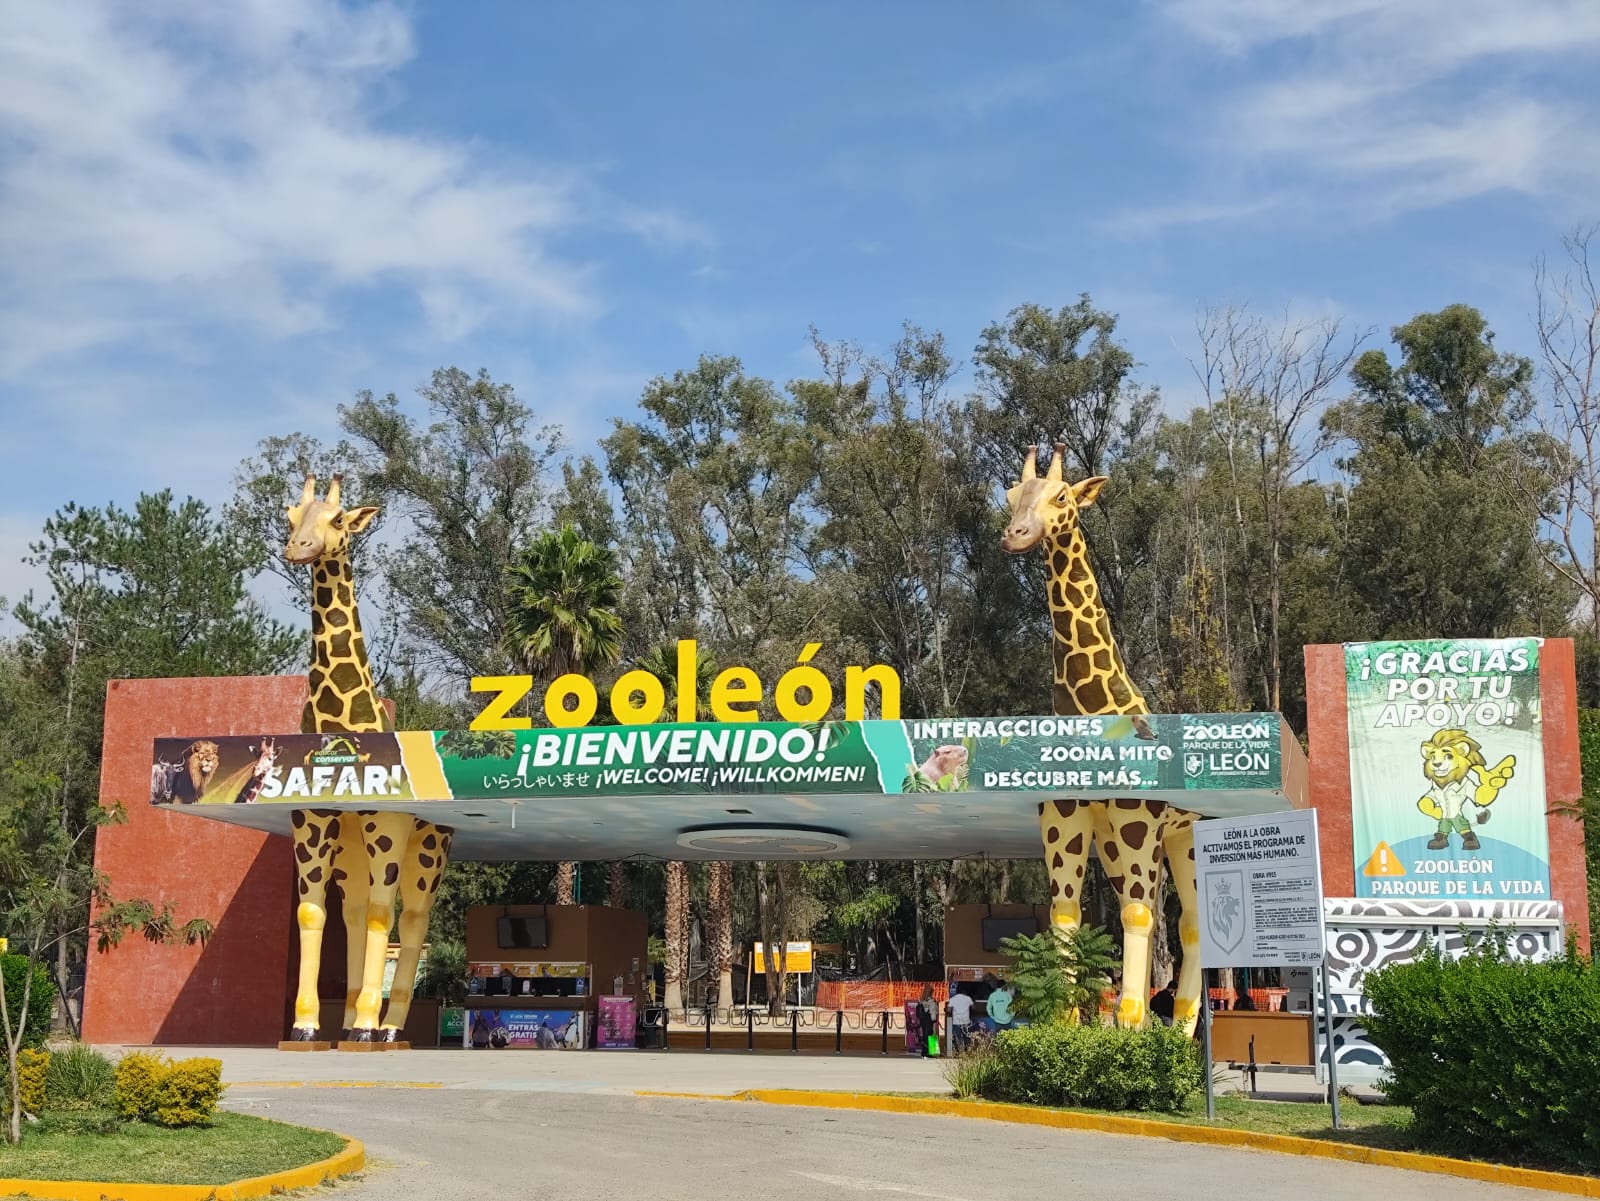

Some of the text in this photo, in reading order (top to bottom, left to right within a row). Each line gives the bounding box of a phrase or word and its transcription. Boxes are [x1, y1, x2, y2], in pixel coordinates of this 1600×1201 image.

[1360, 648, 1529, 681] ¡GRACIAS
[470, 639, 901, 730] zooleón
[1387, 675, 1512, 701] POR TU
[1374, 702, 1515, 728] APOYO!
[913, 719, 1104, 739] INTERACCIONES
[1183, 723, 1270, 740] ZOOLEÓN
[517, 728, 831, 776] ¡BIENVENIDO!
[1041, 745, 1172, 762] ZOONA MITO
[1183, 740, 1270, 750] PARQUE DE LA VIDA
[315, 755, 357, 764] conservar
[1210, 749, 1270, 770] LEÓN
[483, 771, 589, 789] いらっしゃいませ
[596, 766, 866, 789] ¡WELCOME! ¡WILLKOMMEN!
[984, 768, 1159, 787] DESCUBRE MÁS...
[1224, 826, 1280, 840] LEÓN A LA OBRA
[1203, 835, 1305, 853] ACTIVAMOS EL PROGRAMA DE
[1210, 851, 1246, 863] INVERSIÓN
[1263, 848, 1299, 859] HUMANO.
[1414, 857, 1493, 874] ZOOLEÓN
[1372, 880, 1545, 896] PARQUE DE LA VIDA
[509, 1031, 537, 1039] GRATIS
